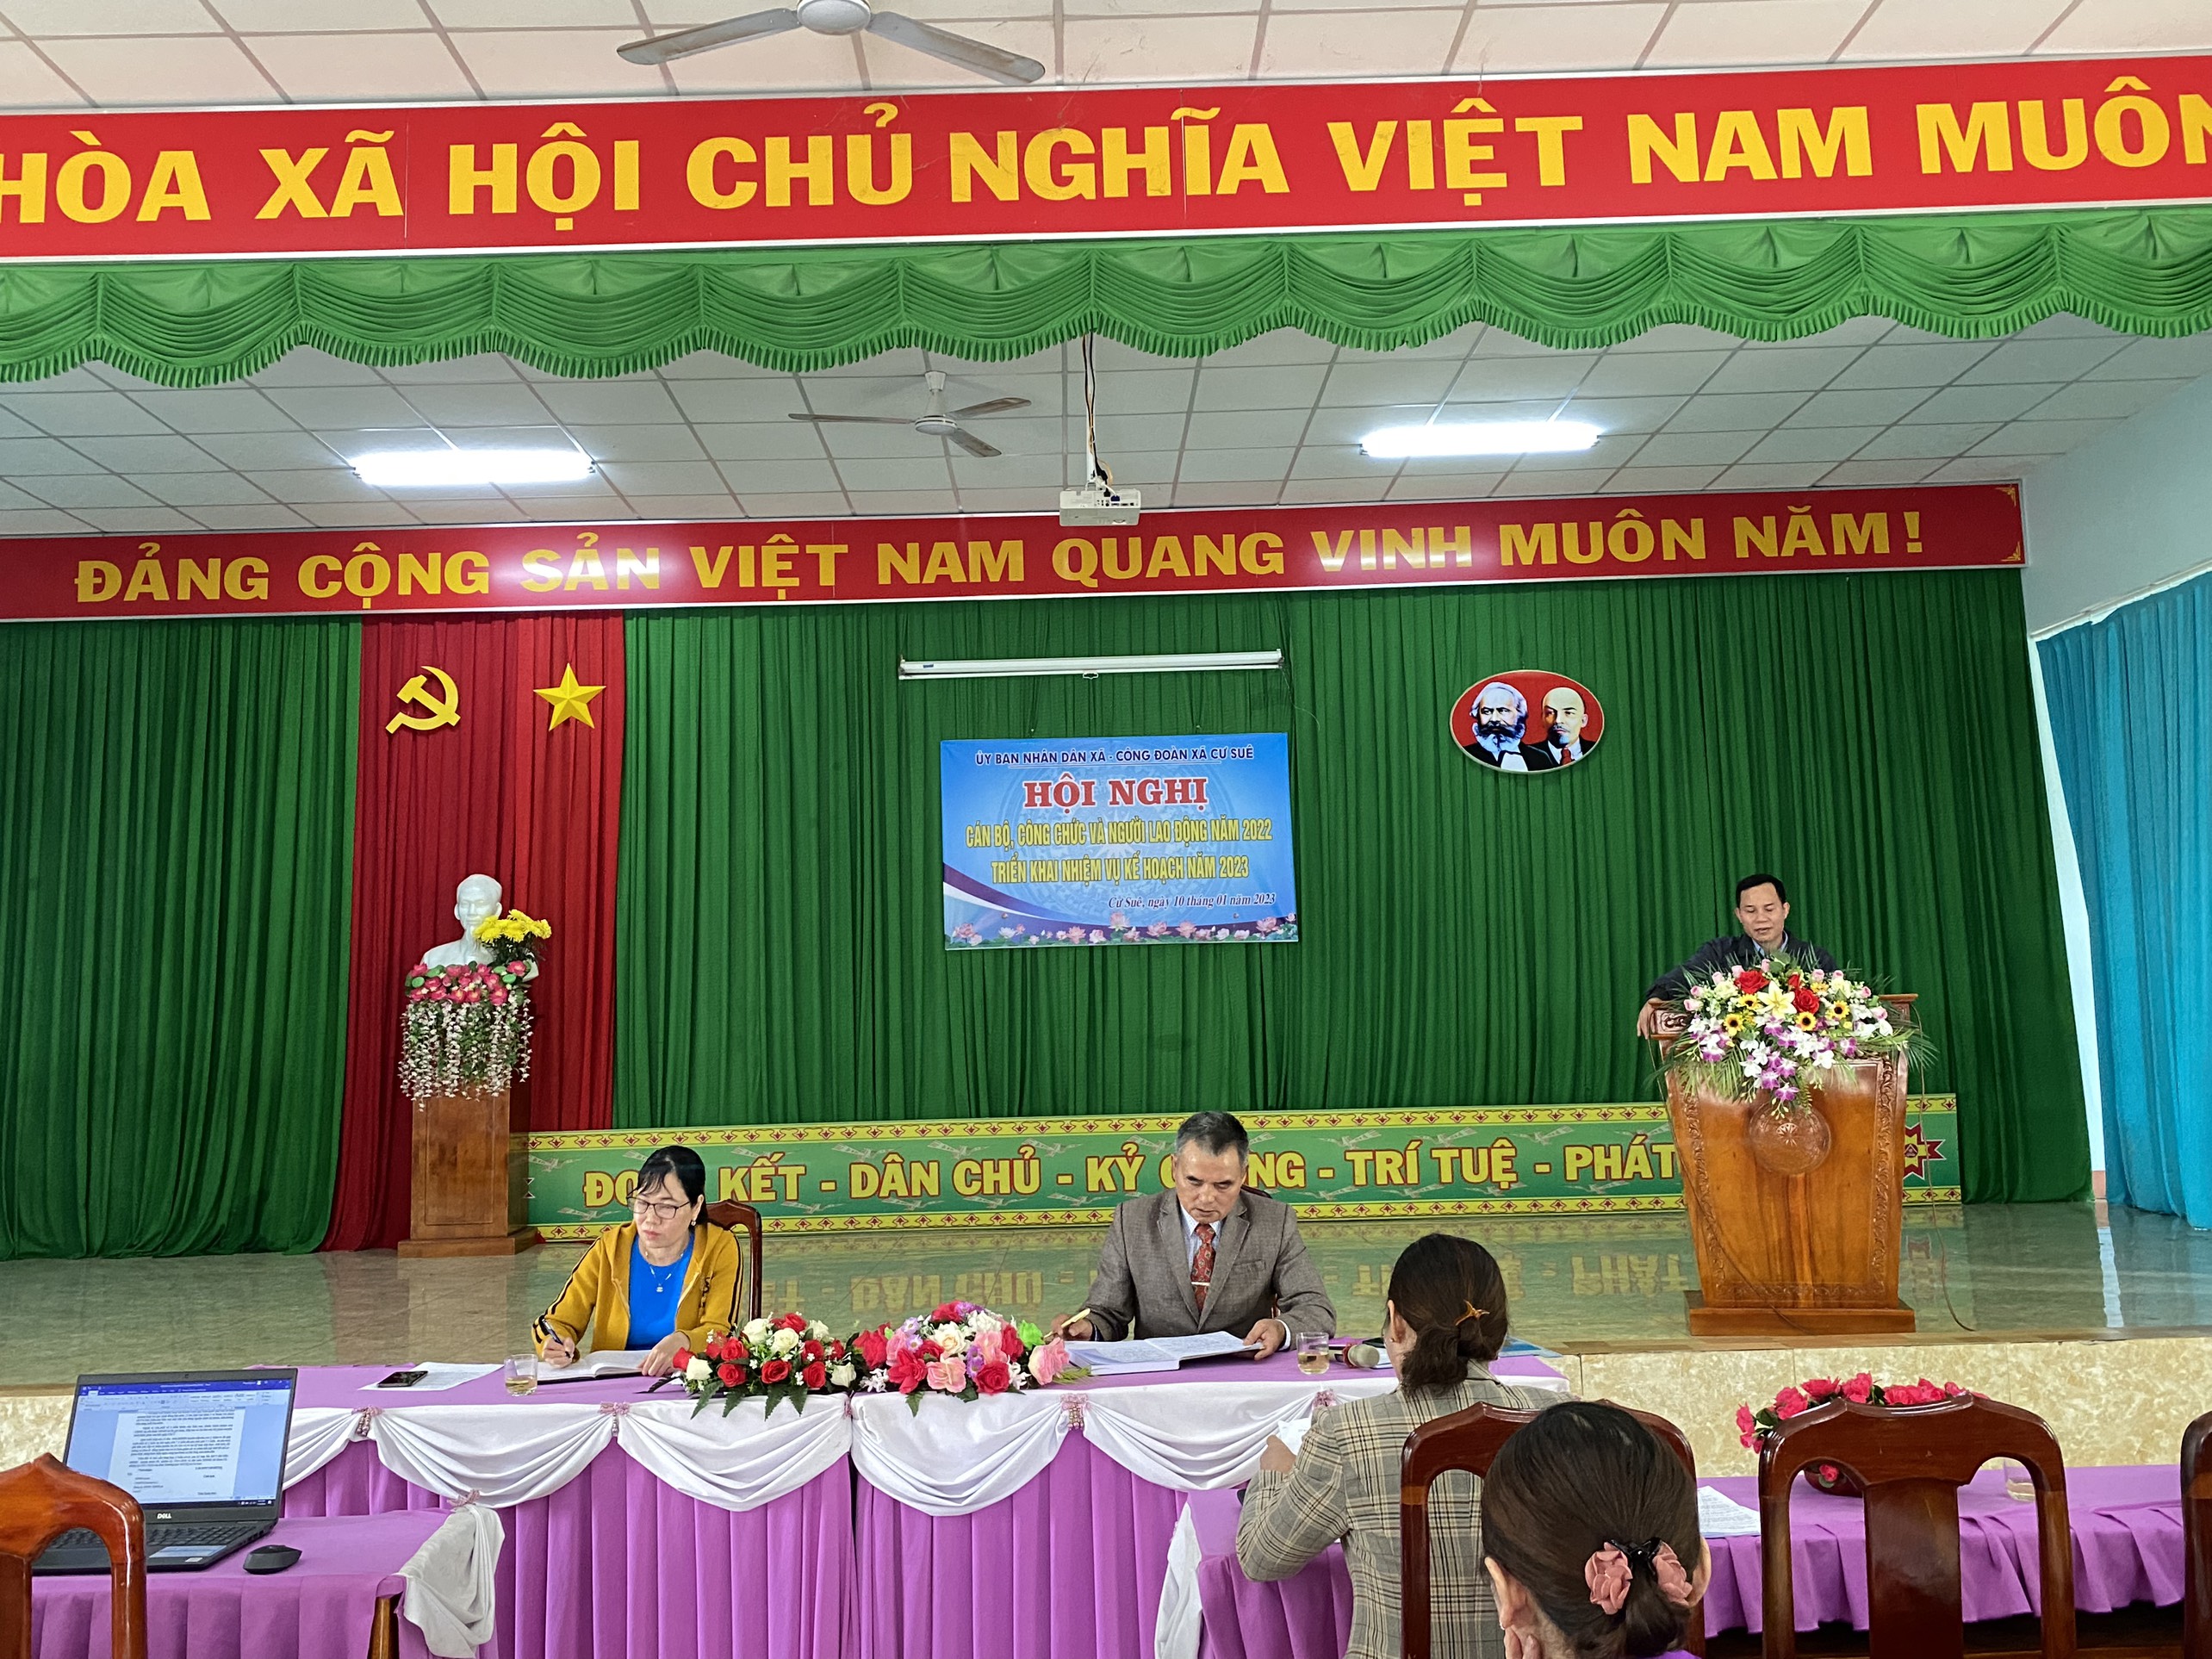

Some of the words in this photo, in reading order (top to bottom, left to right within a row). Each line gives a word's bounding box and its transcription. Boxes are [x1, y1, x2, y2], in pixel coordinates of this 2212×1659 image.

[0, 130, 211, 224] HÒA
[256, 129, 404, 220] XÃ
[449, 122, 640, 231] HỘI
[687, 103, 912, 209] CHỦ
[949, 107, 1290, 202] NGHĨA
[1327, 97, 1583, 207] VIỆT
[1627, 106, 1873, 184] NAM
[74, 542, 270, 603] ĐẢNG
[297, 542, 490, 610] CỘNG
[520, 531, 660, 593] SẢN
[690, 534, 848, 601] VIỆT
[877, 540, 1024, 585] NAM
[1052, 531, 1284, 588] QUANG
[1311, 525, 1472, 572] VINH
[1499, 508, 1706, 566] MUÔN
[976, 750, 992, 765] ỦY
[996, 753, 1019, 765] BAN
[1023, 749, 1058, 763] NHÂN
[1061, 749, 1086, 763] DÂN
[1090, 749, 1106, 762] XÃ
[1115, 748, 1151, 761] CÔNG
[1154, 745, 1188, 761] ĐOÀN
[1191, 746, 1207, 760] XÃ
[1210, 747, 1227, 760] CƯ
[1231, 744, 1254, 759] SUÊ
[1023, 773, 1097, 814] HỘI
[1109, 778, 1209, 811] NGHỊ
[966, 820, 991, 848] CÁN
[994, 819, 1015, 852] BỘ,
[1017, 818, 1051, 846] CÔNG
[1053, 817, 1086, 845] CHỨC
[1089, 817, 1106, 845] VÀ
[1108, 815, 1146, 844] NGƯỜI
[1148, 819, 1171, 842] LAO
[1173, 815, 1208, 848] ĐỘNG
[1210, 814, 1240, 842] NĂM
[1242, 818, 1272, 842] 2022
[991, 851, 1027, 884] TRIỂN
[1030, 860, 1059, 883] KHAI
[1062, 854, 1102, 887] NHIỆM
[1104, 858, 1121, 886] VỤ
[1123, 850, 1140, 880] KẾ
[1142, 856, 1184, 885] HOẠCH
[1187, 851, 1216, 879] NĂM
[1219, 855, 1249, 879] 2023
[1147, 896, 1170, 910] ngày
[1174, 895, 1185, 907] 10
[1187, 894, 1214, 907] tháng
[1216, 894, 1227, 905] 01
[1229, 895, 1251, 905] năm
[1253, 893, 1276, 905] 2023
[718, 1152, 807, 1202] KẾT
[848, 1152, 941, 1199] DÂN
[952, 1144, 1041, 1196] CHỦ
[1085, 1141, 1146, 1192] KỶ
[1345, 1139, 1423, 1186] TRÍ
[1430, 1137, 1519, 1190] TUỆ
[1563, 1134, 1676, 1182] PHÁT
